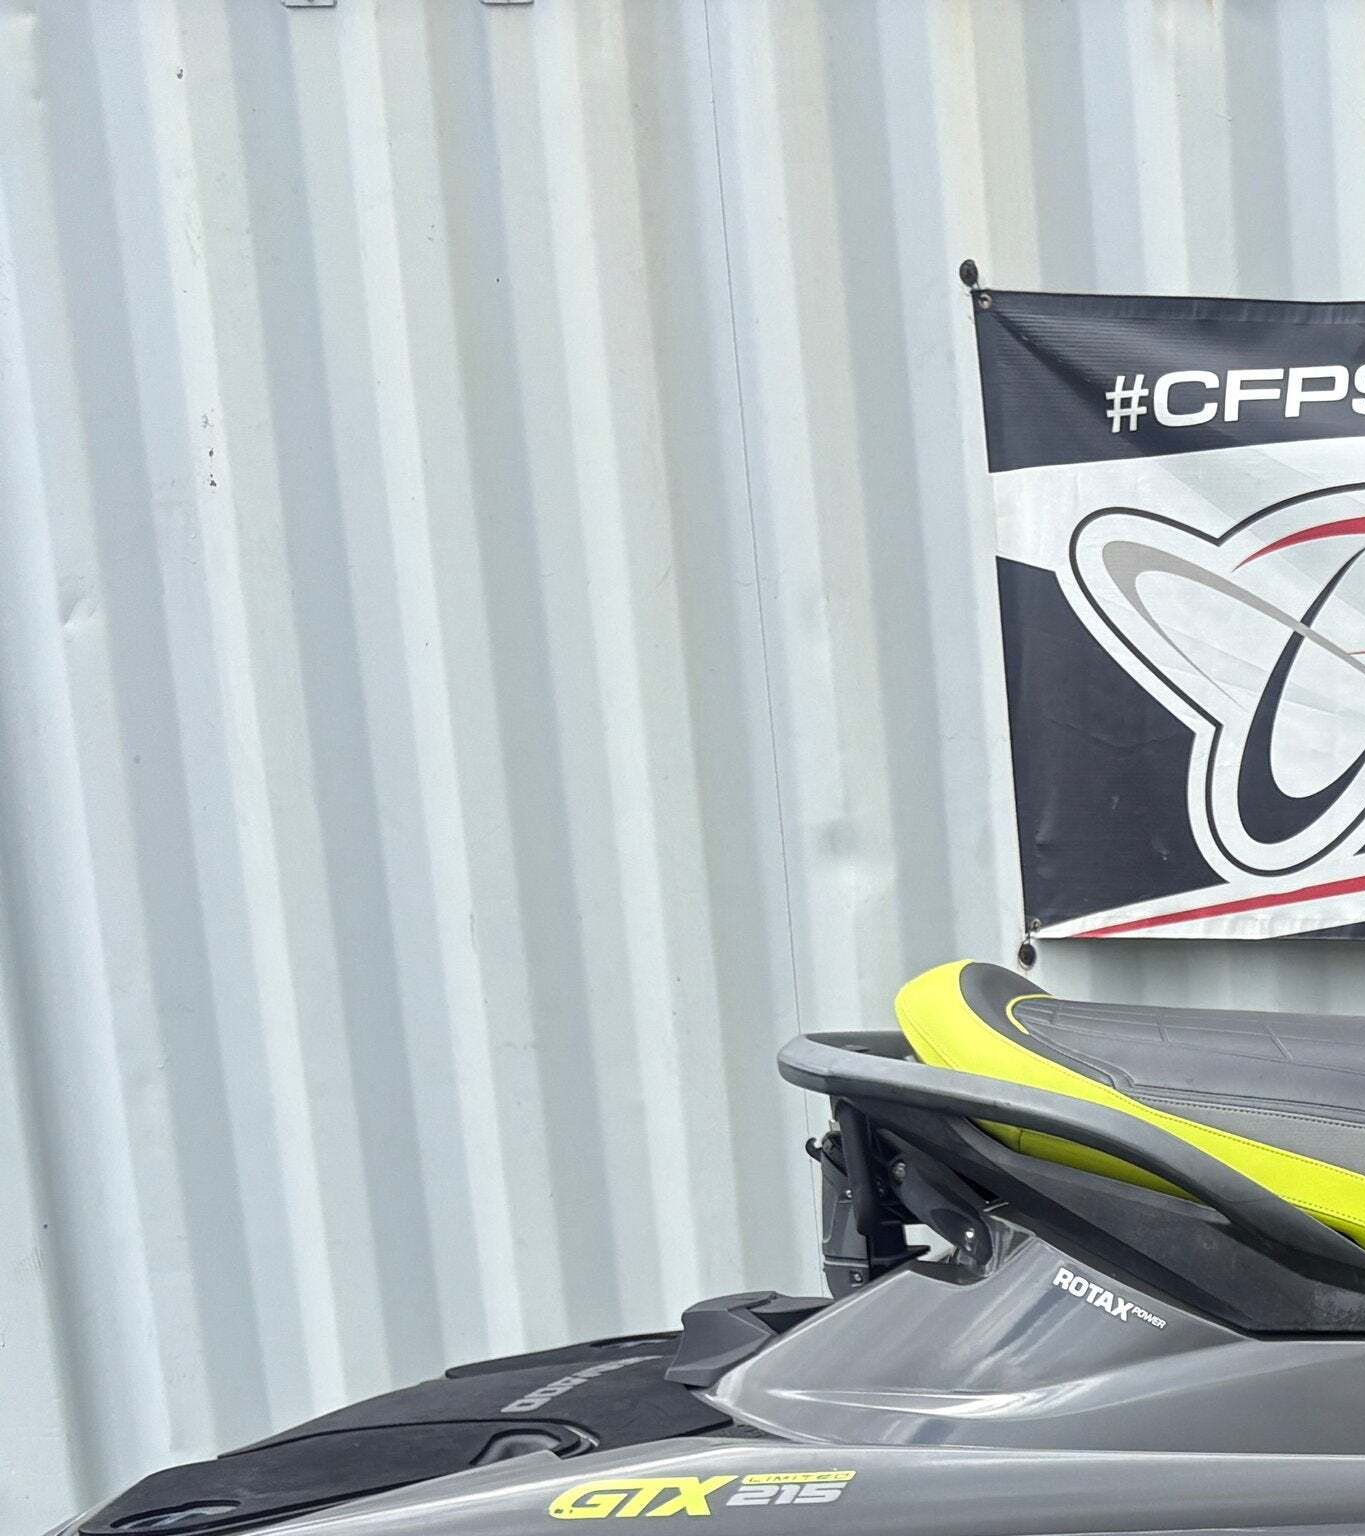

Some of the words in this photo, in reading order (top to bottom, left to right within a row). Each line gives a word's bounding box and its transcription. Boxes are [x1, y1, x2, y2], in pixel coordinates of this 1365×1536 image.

[1053, 1267, 1134, 1321] ROTAX
[1131, 1306, 1166, 1328] POWER
[549, 1475, 739, 1519] GTX
[726, 1482, 847, 1506] 215
